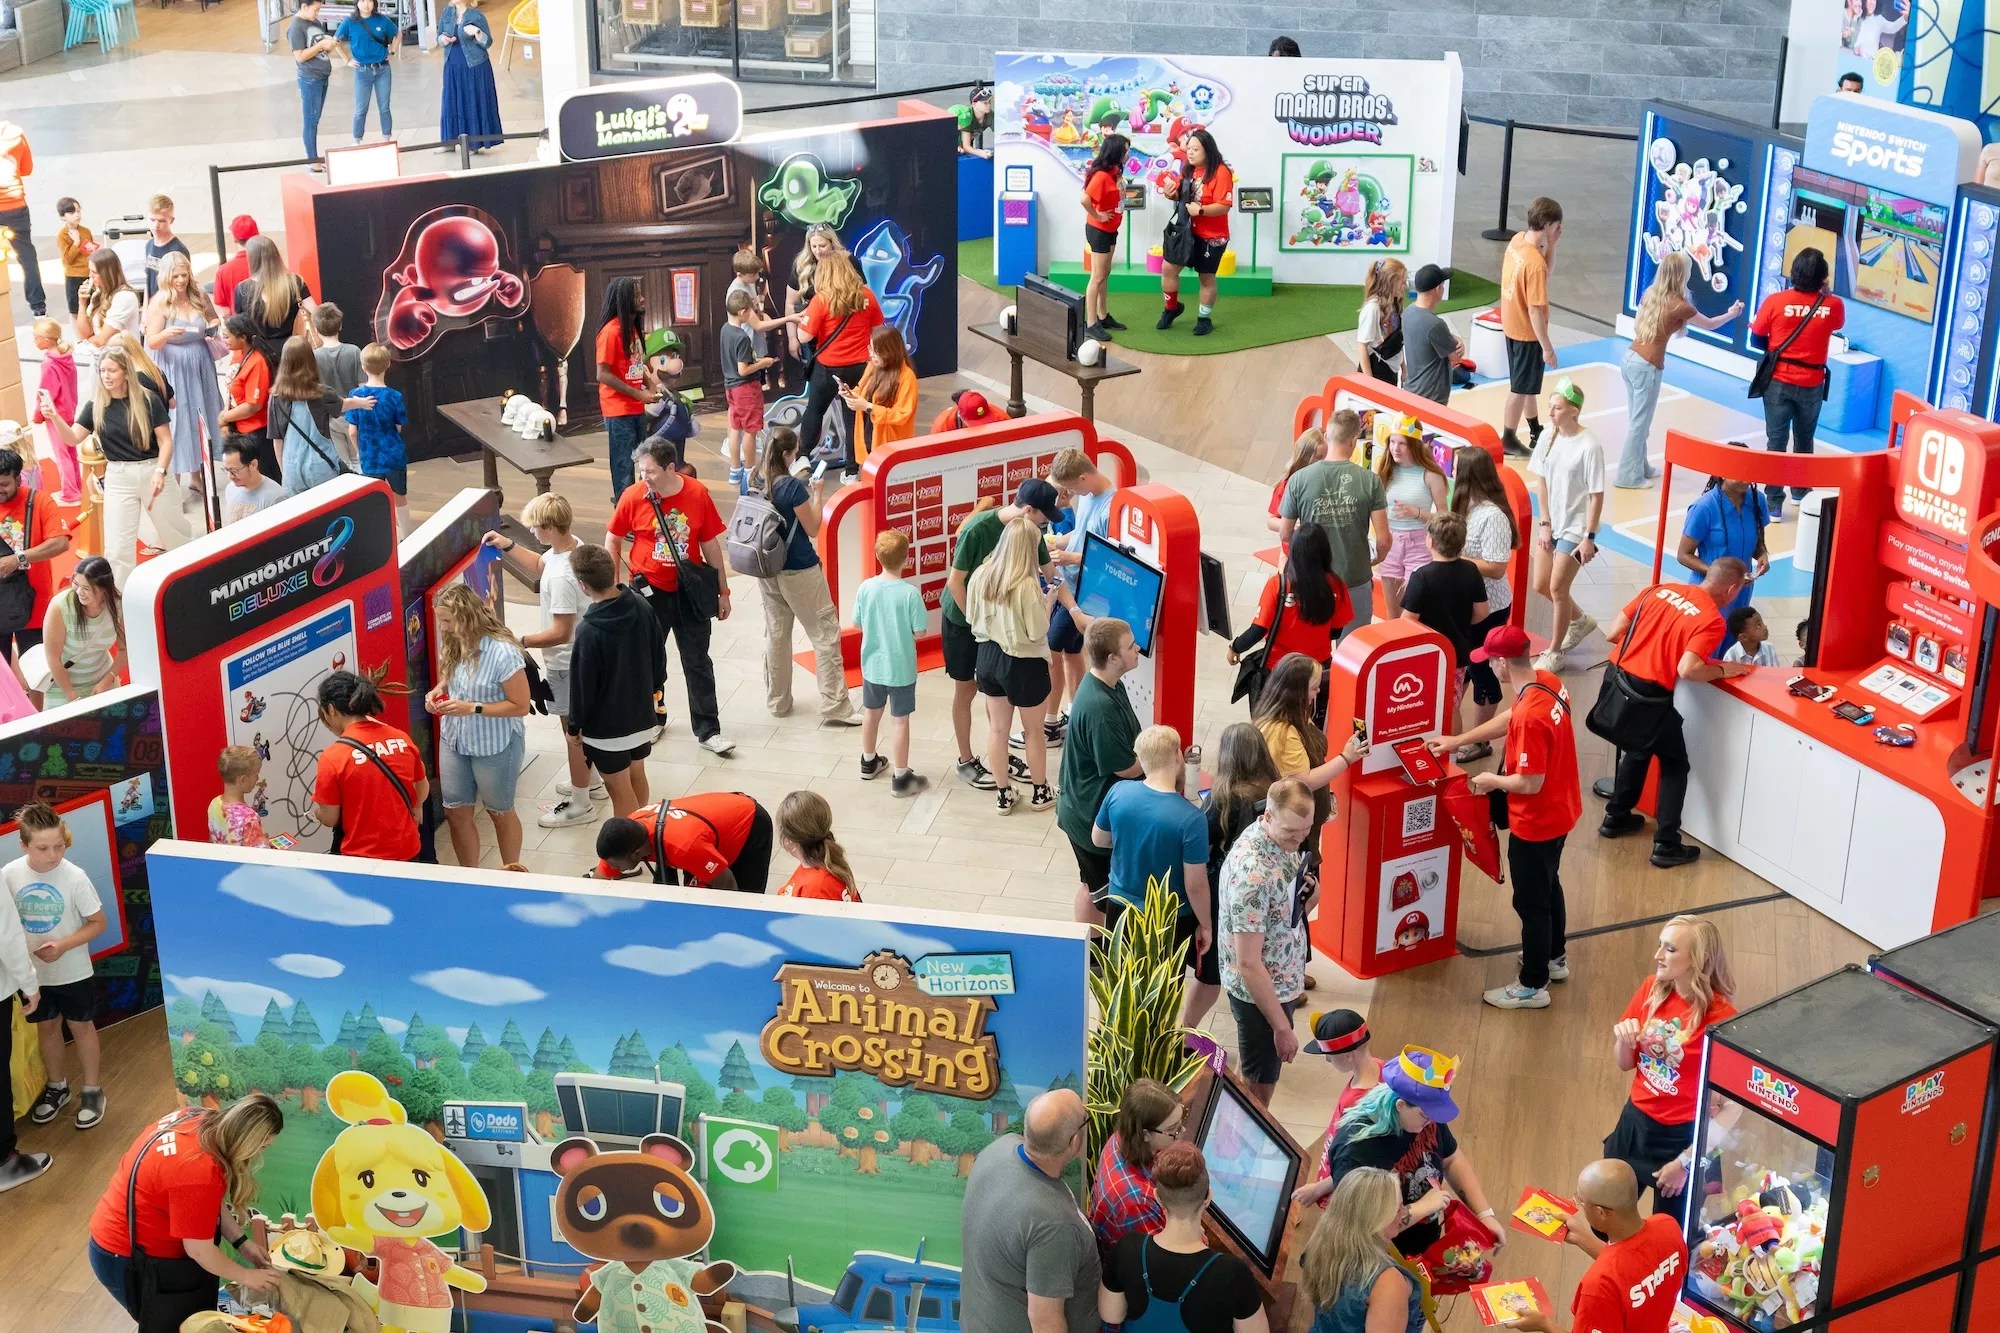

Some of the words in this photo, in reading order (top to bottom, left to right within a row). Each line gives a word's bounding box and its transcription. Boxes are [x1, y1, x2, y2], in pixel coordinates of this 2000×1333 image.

[1304, 75, 1365, 92] SUPER
[596, 104, 667, 132] Luigi's
[1275, 93, 1337, 120] MARIO
[1339, 94, 1393, 120] BROS.
[1288, 118, 1380, 145] WONDER
[1836, 121, 1887, 142] NINTENDO
[1888, 134, 1928, 153] SWITCH
[1831, 131, 1924, 177] Sports
[1904, 484, 1967, 518] NINTENDO
[312, 515, 355, 587] 8
[1888, 534, 1905, 550] Play
[1905, 543, 1937, 564] anytime,
[1104, 562, 1139, 587] YOURSELF
[1908, 555, 1942, 578] Nintendo
[1943, 570, 1971, 590] Switch
[229, 570, 309, 622] DELUXE
[1655, 588, 1701, 617] STAFF
[1914, 609, 1937, 622] different
[1935, 619, 1947, 627] play
[242, 653, 266, 667] FOLLOW
[266, 646, 276, 656] THE
[278, 640, 290, 650] BLUE
[292, 631, 307, 644] SHELL
[1387, 706, 1398, 714] My
[1396, 700, 1424, 711] Nintendo
[351, 738, 408, 765] SAFF
[926, 959, 964, 975] New
[814, 980, 857, 992] Welcome
[859, 982, 871, 993] to
[929, 976, 1009, 993] Horizons
[788, 979, 982, 1045] Animal
[769, 1024, 989, 1092] Crossing
[1639, 1053, 1680, 1082] PLAY
[1748, 1081, 1799, 1113] NINTENDO
[1753, 1067, 1799, 1099] PLAY
[1907, 1072, 1943, 1100] PLAY
[1901, 1086, 1943, 1112] NINTENDO
[486, 1113, 518, 1127] Dodo
[1629, 1251, 1680, 1309] STAFF
